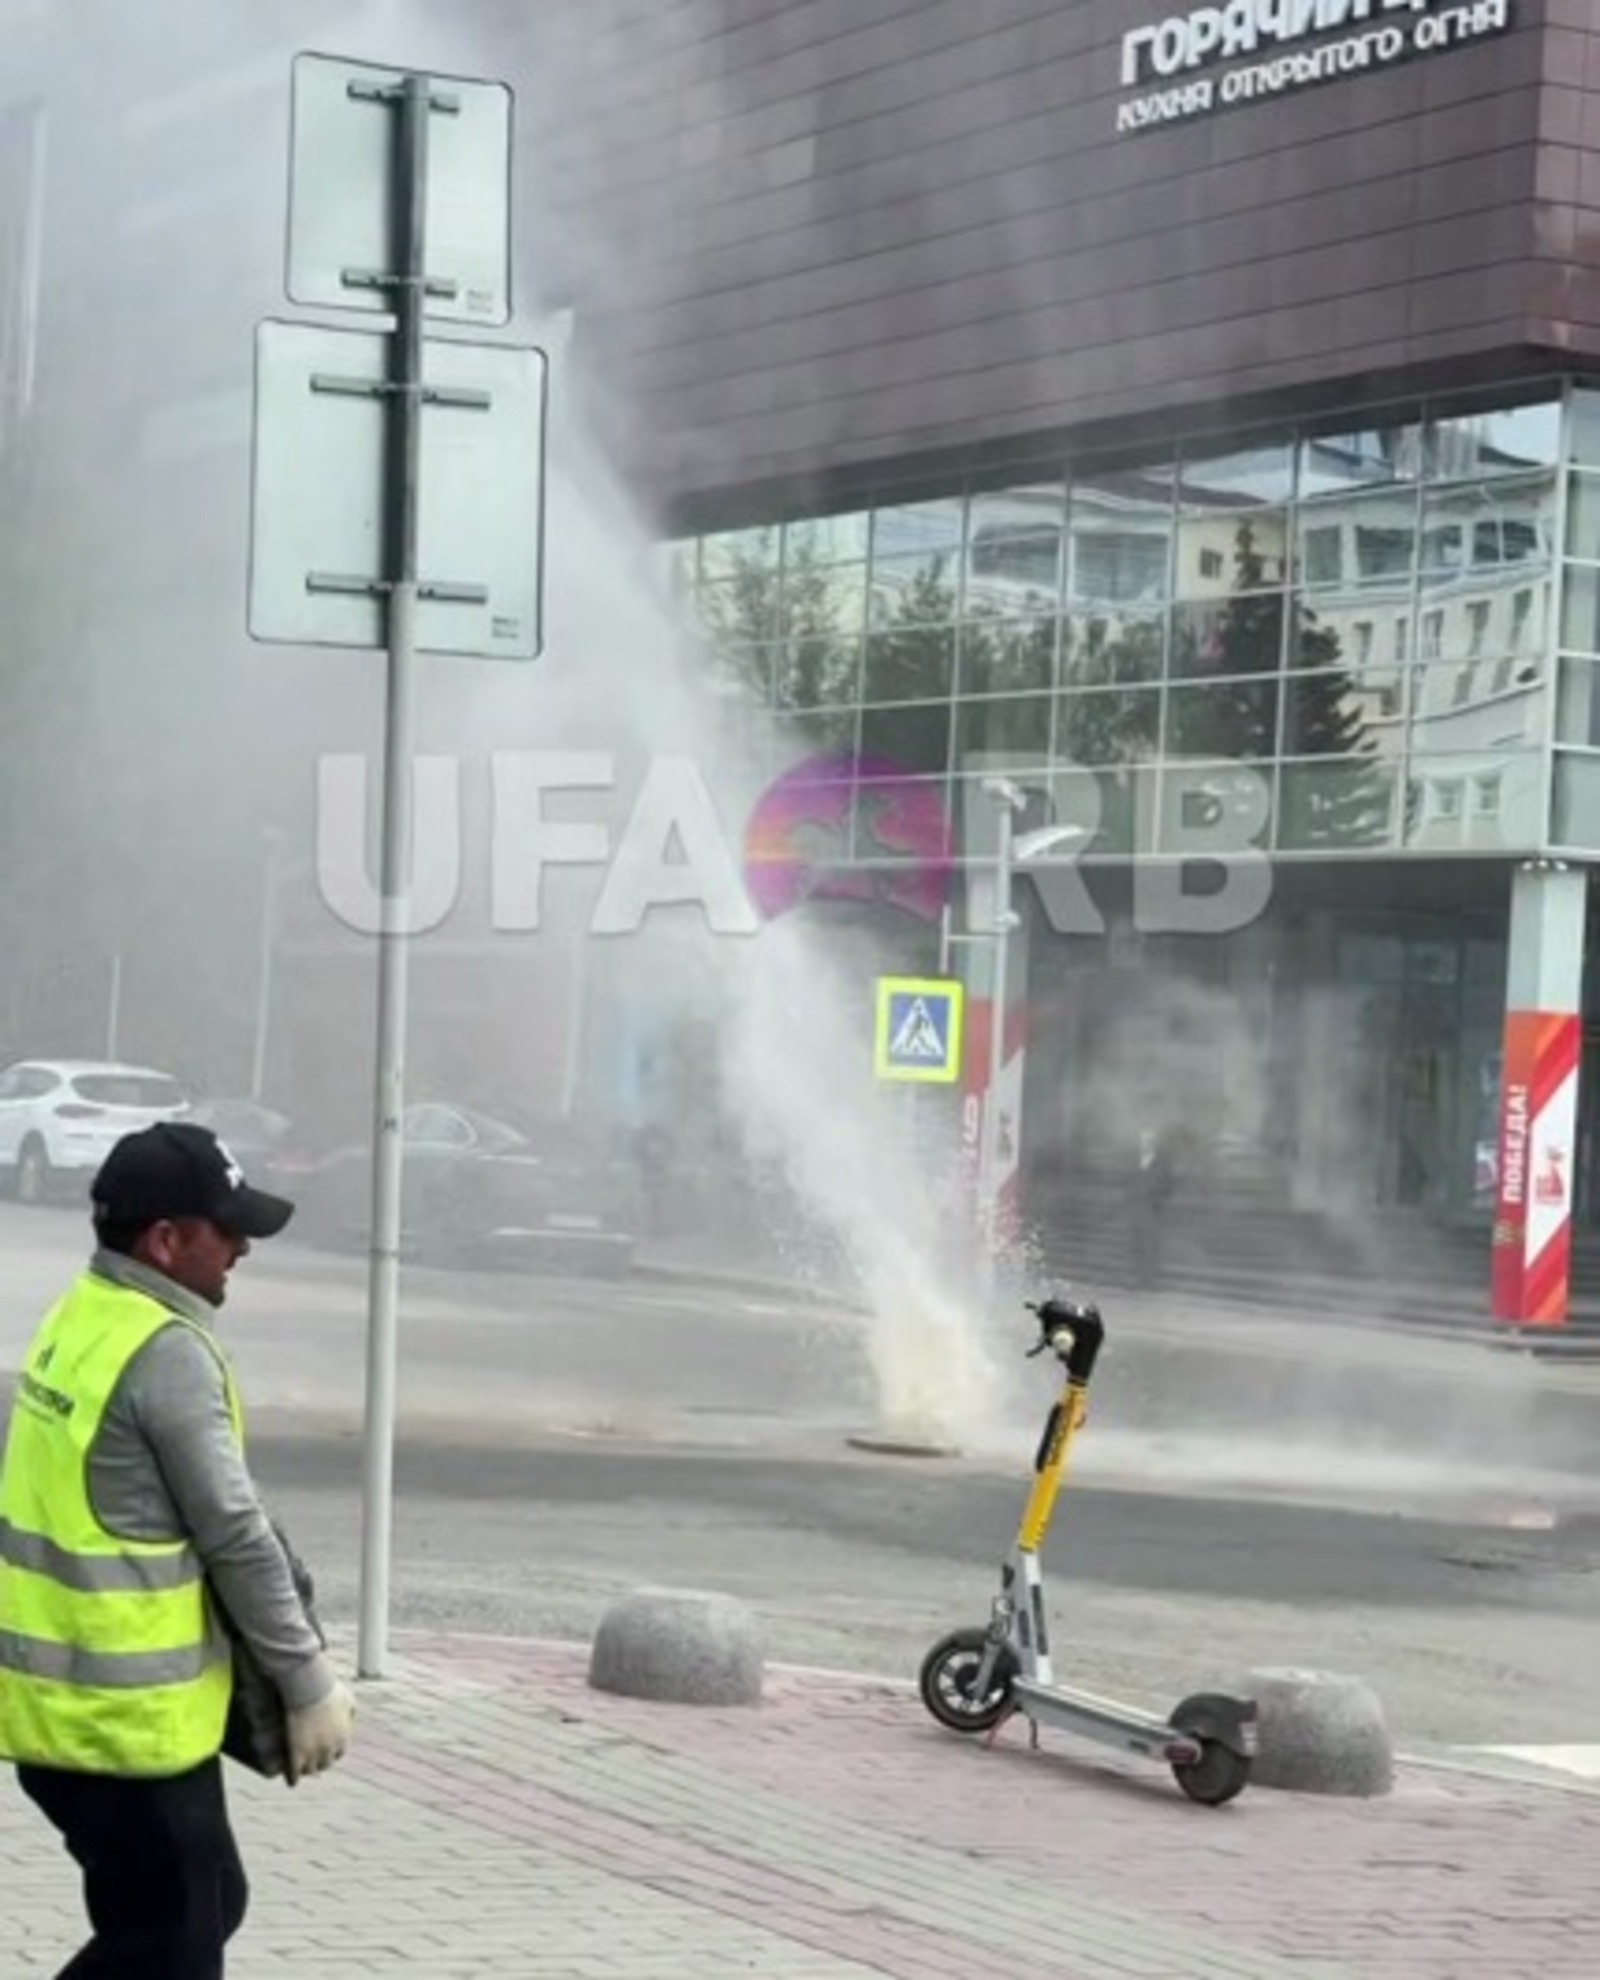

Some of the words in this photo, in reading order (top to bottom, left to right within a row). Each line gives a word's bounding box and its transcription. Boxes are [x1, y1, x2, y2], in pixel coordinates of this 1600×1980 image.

[1117, 80, 1212, 131] КУХНЯ
[1220, 27, 1403, 101] ОТКРЫТОГО
[1413, 0, 1507, 48] ОГНЯ
[1502, 1084, 1529, 1203] ПОБЕДА!
